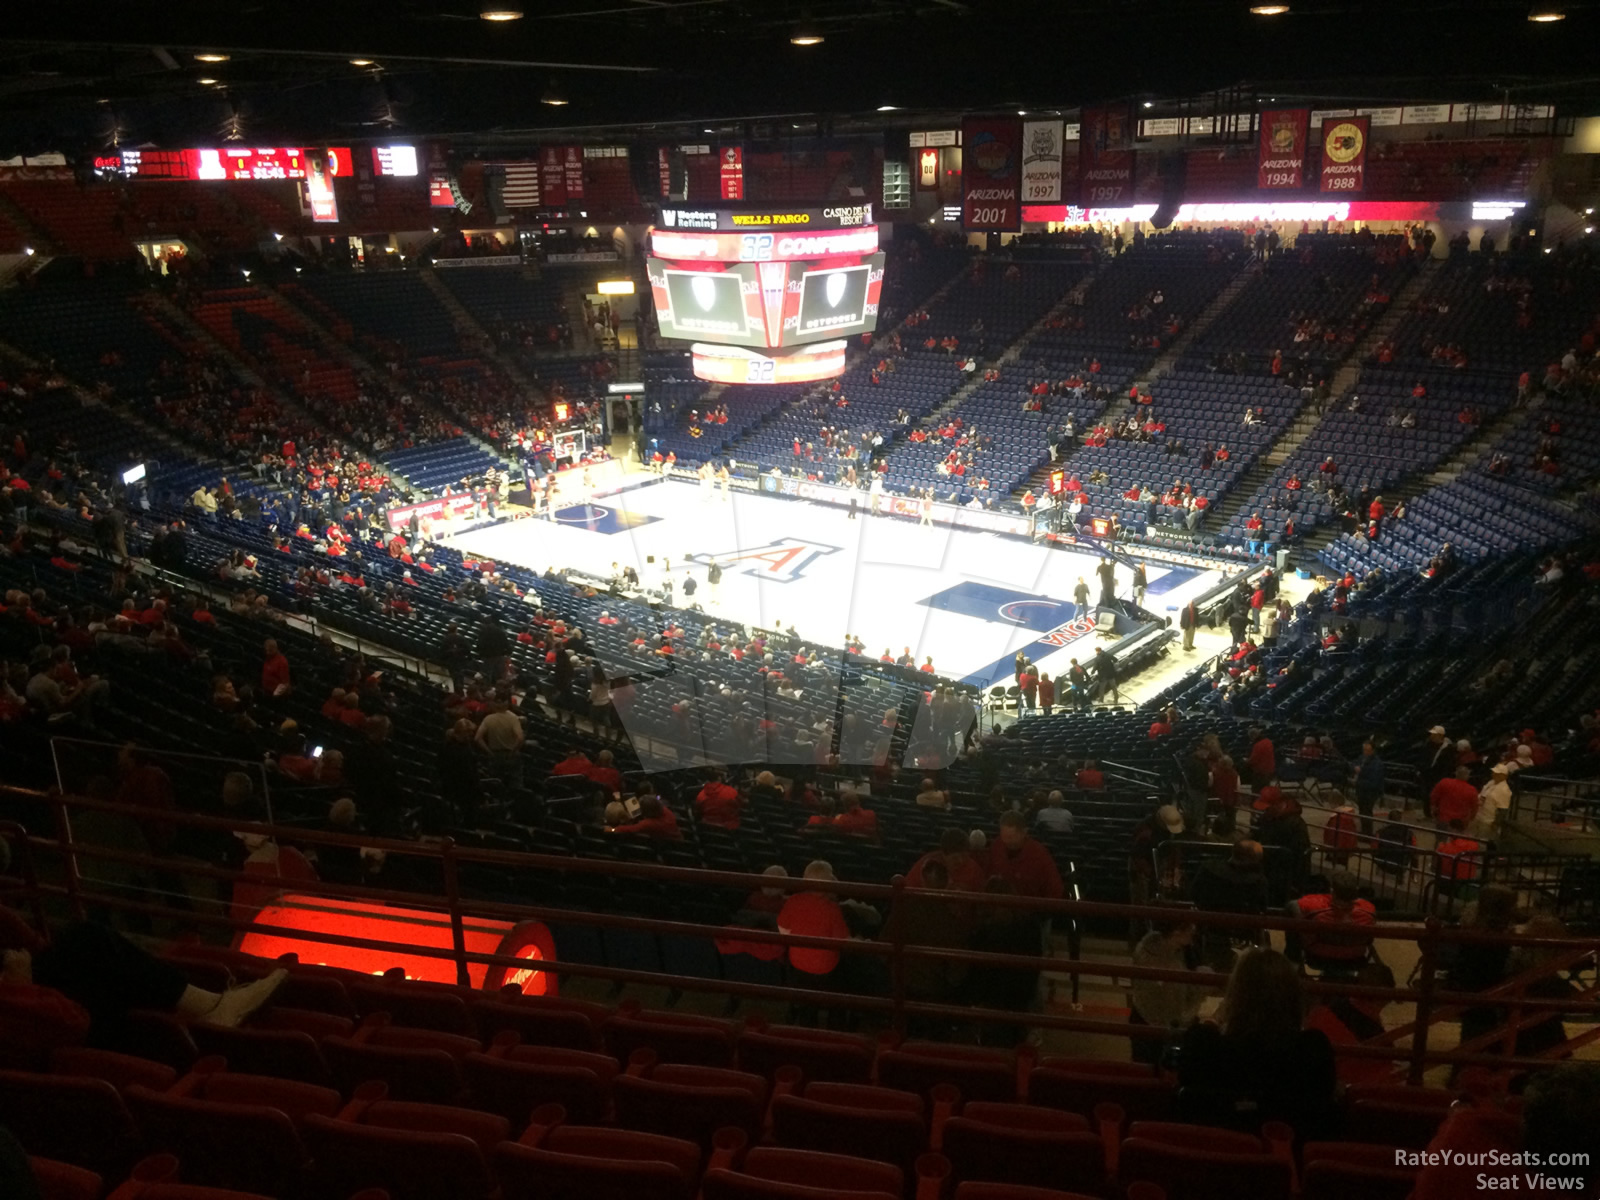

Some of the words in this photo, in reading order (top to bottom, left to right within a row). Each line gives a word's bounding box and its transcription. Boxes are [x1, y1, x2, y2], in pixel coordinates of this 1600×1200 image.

[924, 165, 934, 174] 00
[1261, 159, 1302, 169] ARIZONA
[1323, 165, 1362, 174] ARIZONA
[1023, 171, 1060, 181] ARIZONA
[1085, 169, 1129, 180] ARIZONA
[1266, 173, 1295, 185] 1994
[1327, 178, 1356, 189] 1988
[967, 189, 1015, 201] ARIZONA
[1029, 186, 1054, 198] 1997
[1090, 186, 1122, 201] 1997
[677, 211, 717, 220] Western
[823, 207, 852, 218] CASINO
[972, 207, 1007, 224] 2001
[678, 218, 718, 230] Refining
[732, 215, 771, 225] WELLS
[772, 213, 810, 225] FARGO
[840, 215, 863, 226] RESORT
[740, 235, 772, 261] 32
[748, 361, 775, 381] 32
[1155, 531, 1192, 541] NETWORKS
